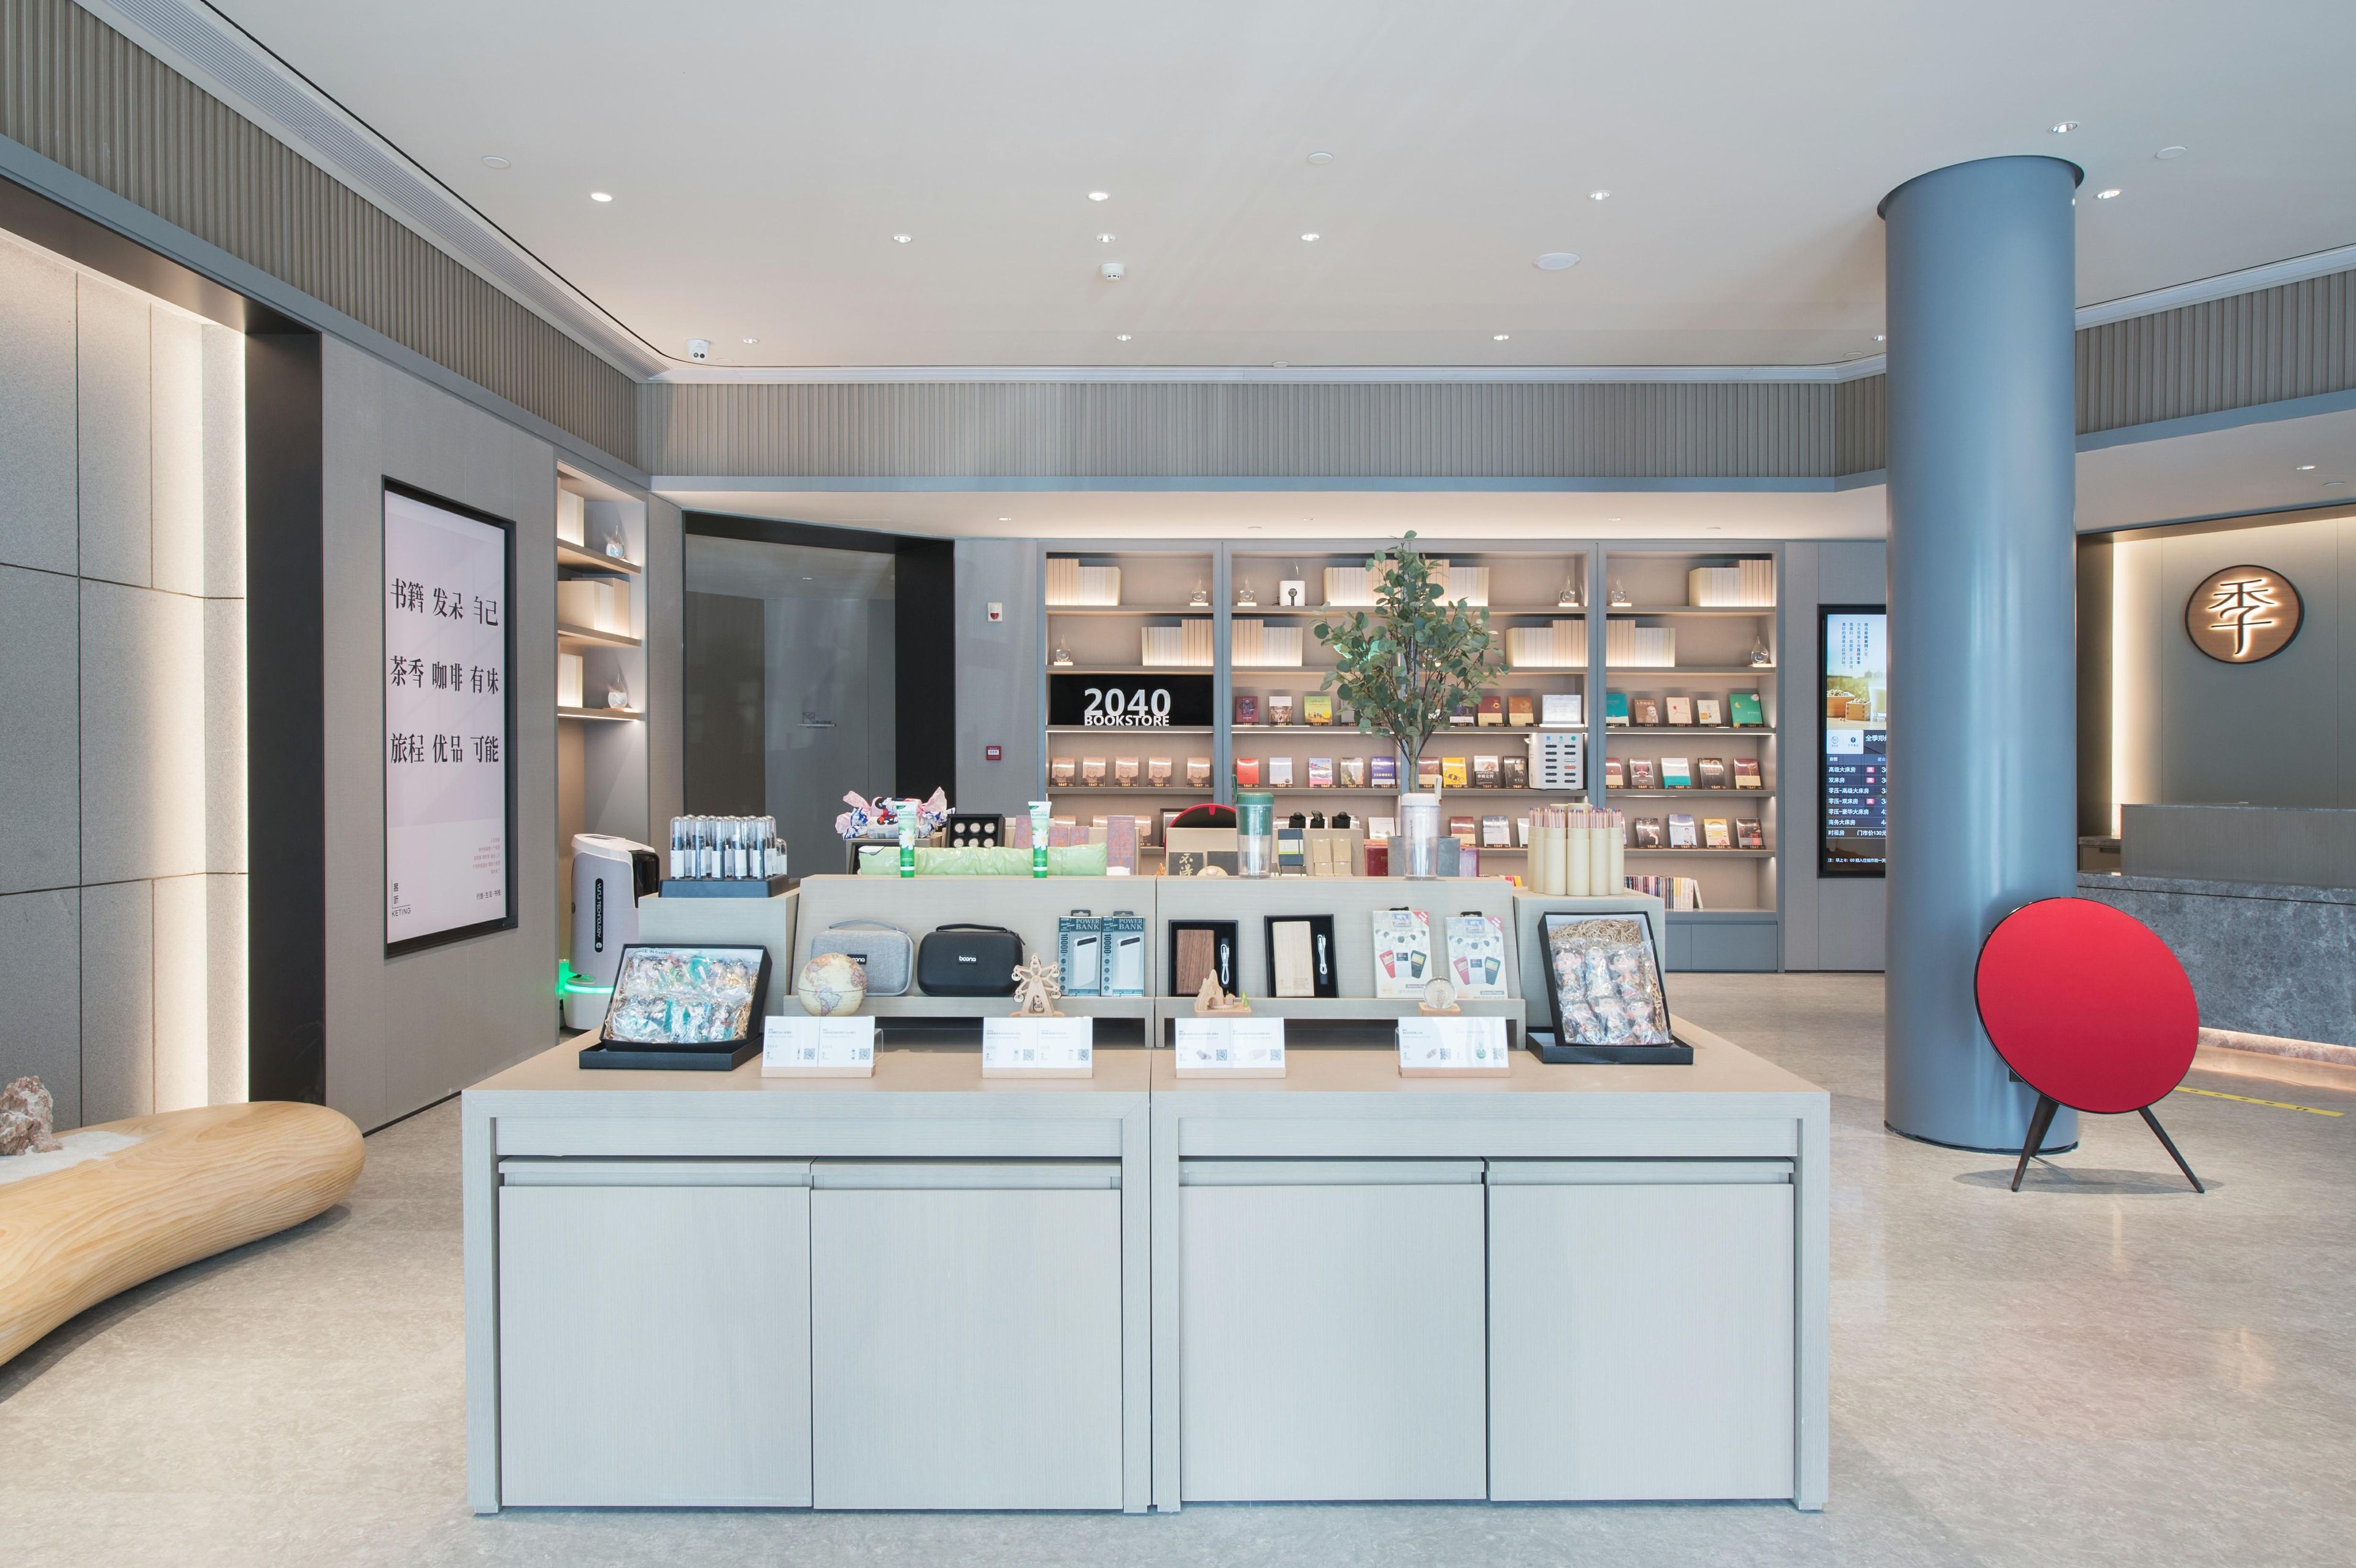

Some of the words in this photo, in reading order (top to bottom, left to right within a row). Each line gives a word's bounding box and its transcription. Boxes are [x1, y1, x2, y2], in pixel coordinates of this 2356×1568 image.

[2207, 578, 2275, 655] 季
[432, 661, 463, 691] 咖啡
[1085, 688, 1171, 717] 2040
[1084, 715, 1169, 726] BOOKSTORE
[390, 733, 424, 764] 旅程
[433, 734, 463, 763] 优品
[470, 736, 499, 763] 可能
[391, 907, 411, 917] KETING
[1060, 934, 1069, 954] 10000
